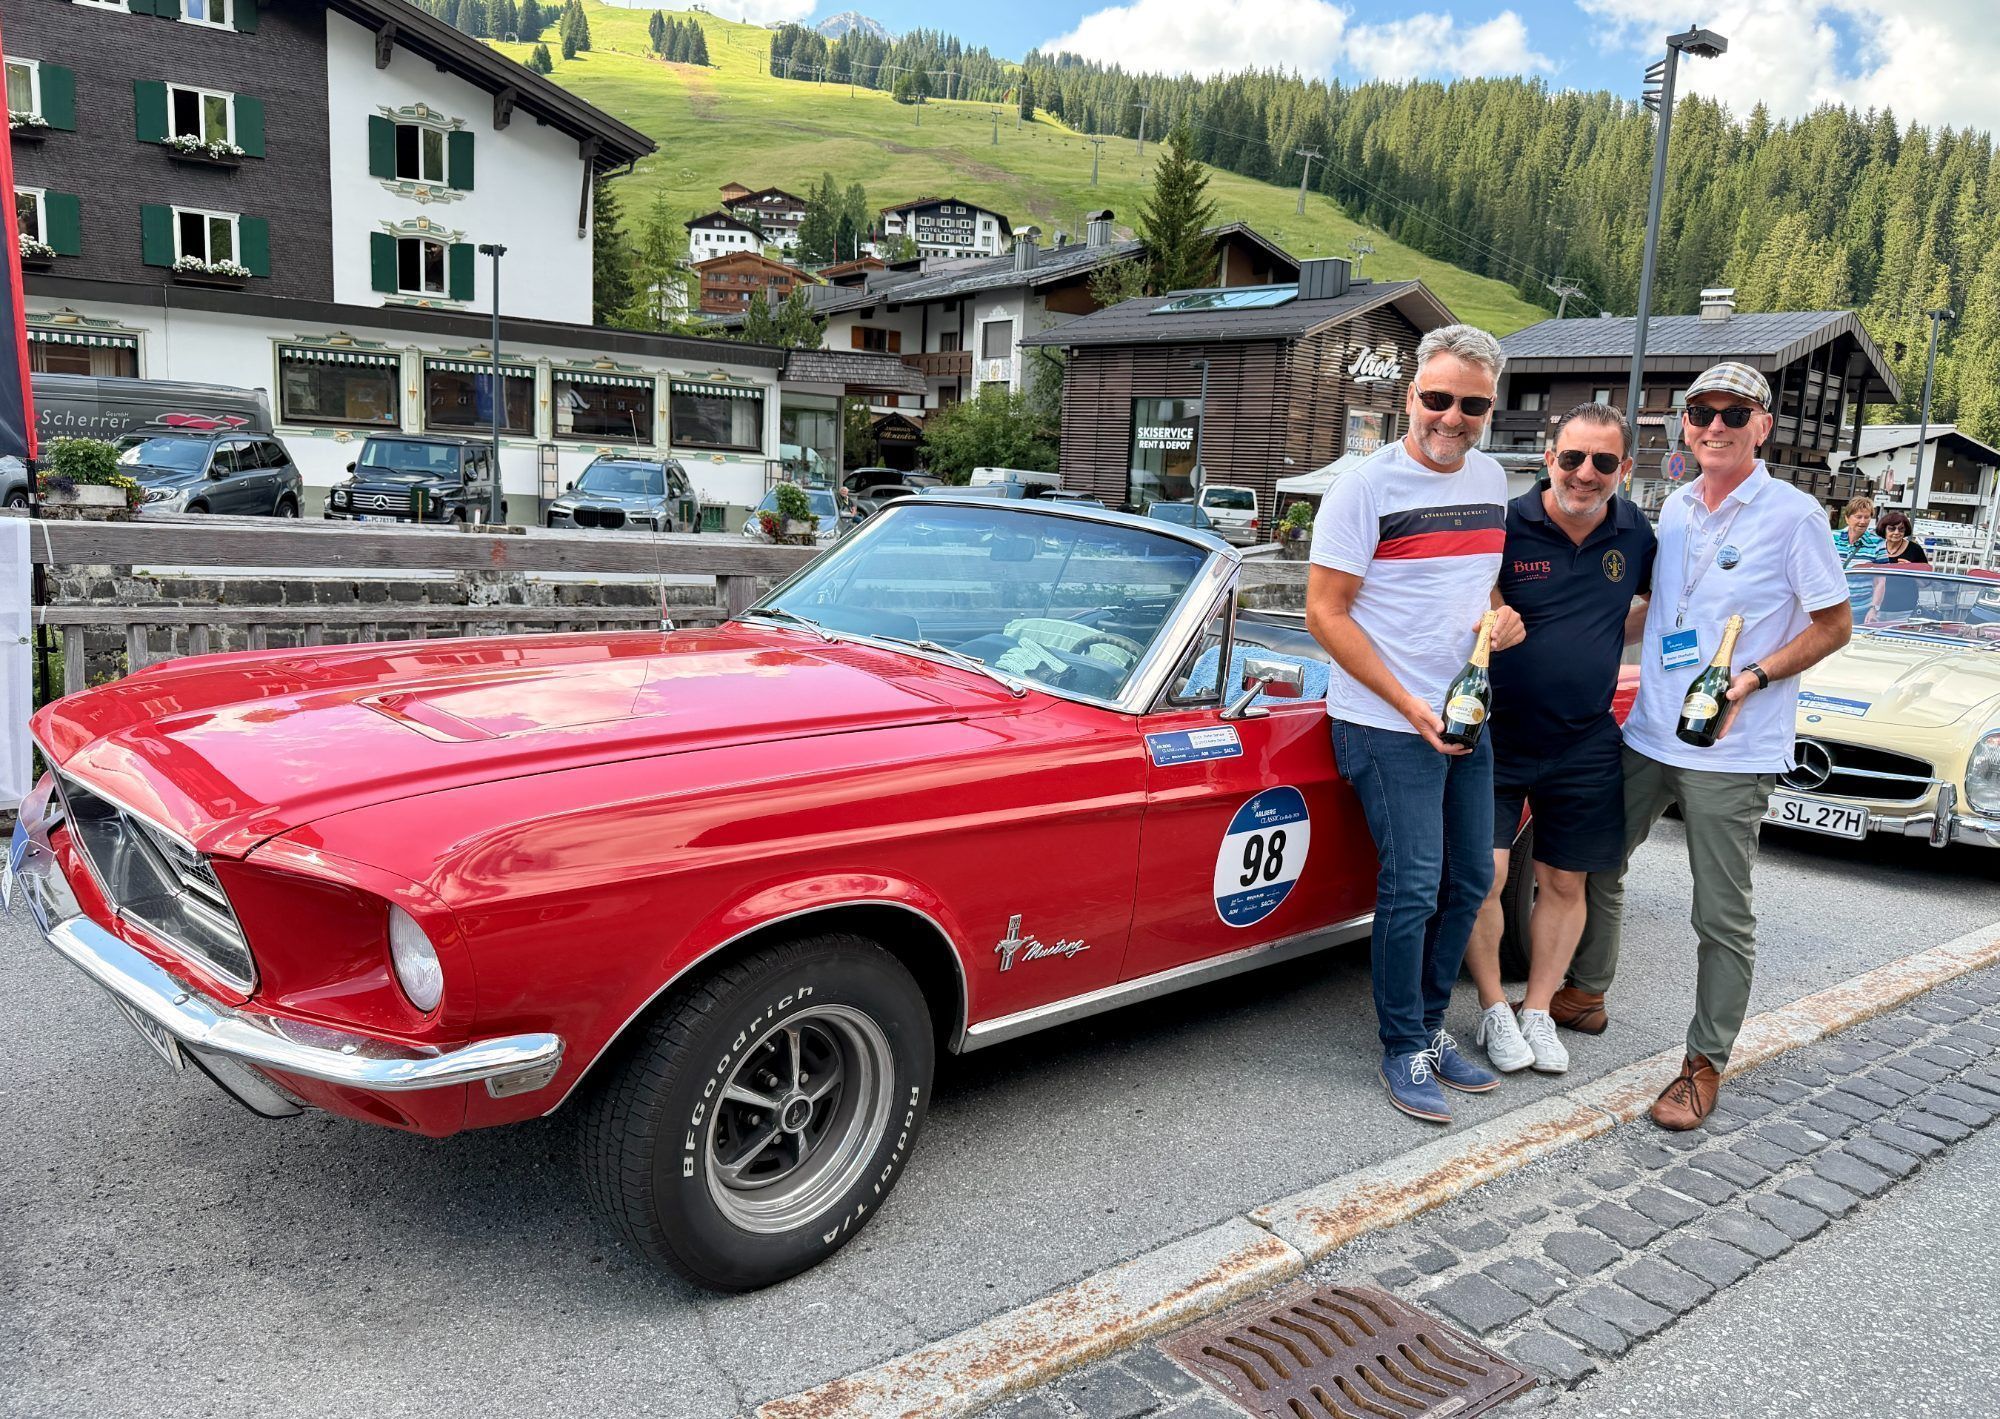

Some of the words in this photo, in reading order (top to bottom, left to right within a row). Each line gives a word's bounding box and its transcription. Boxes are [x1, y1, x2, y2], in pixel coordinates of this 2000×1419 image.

[41, 409, 130, 429] Scherrer
[1137, 427, 1194, 439] SKISERVICE
[1347, 436, 1386, 448] KISERVICE
[1139, 440, 1158, 449] RENT
[1159, 441, 1165, 449] &
[1166, 441, 1191, 450] DEPOT
[1513, 560, 1551, 573] Burg
[1254, 808, 1277, 818] ARLBERG
[1782, 801, 1811, 824] SL
[1815, 807, 1862, 833] 27H
[1240, 829, 1287, 887] 98
[1022, 938, 1091, 962] Mustang
[683, 986, 814, 1178] BFGoodrich
[874, 1086, 920, 1194] Radial
[823, 1203, 869, 1244] T/A
